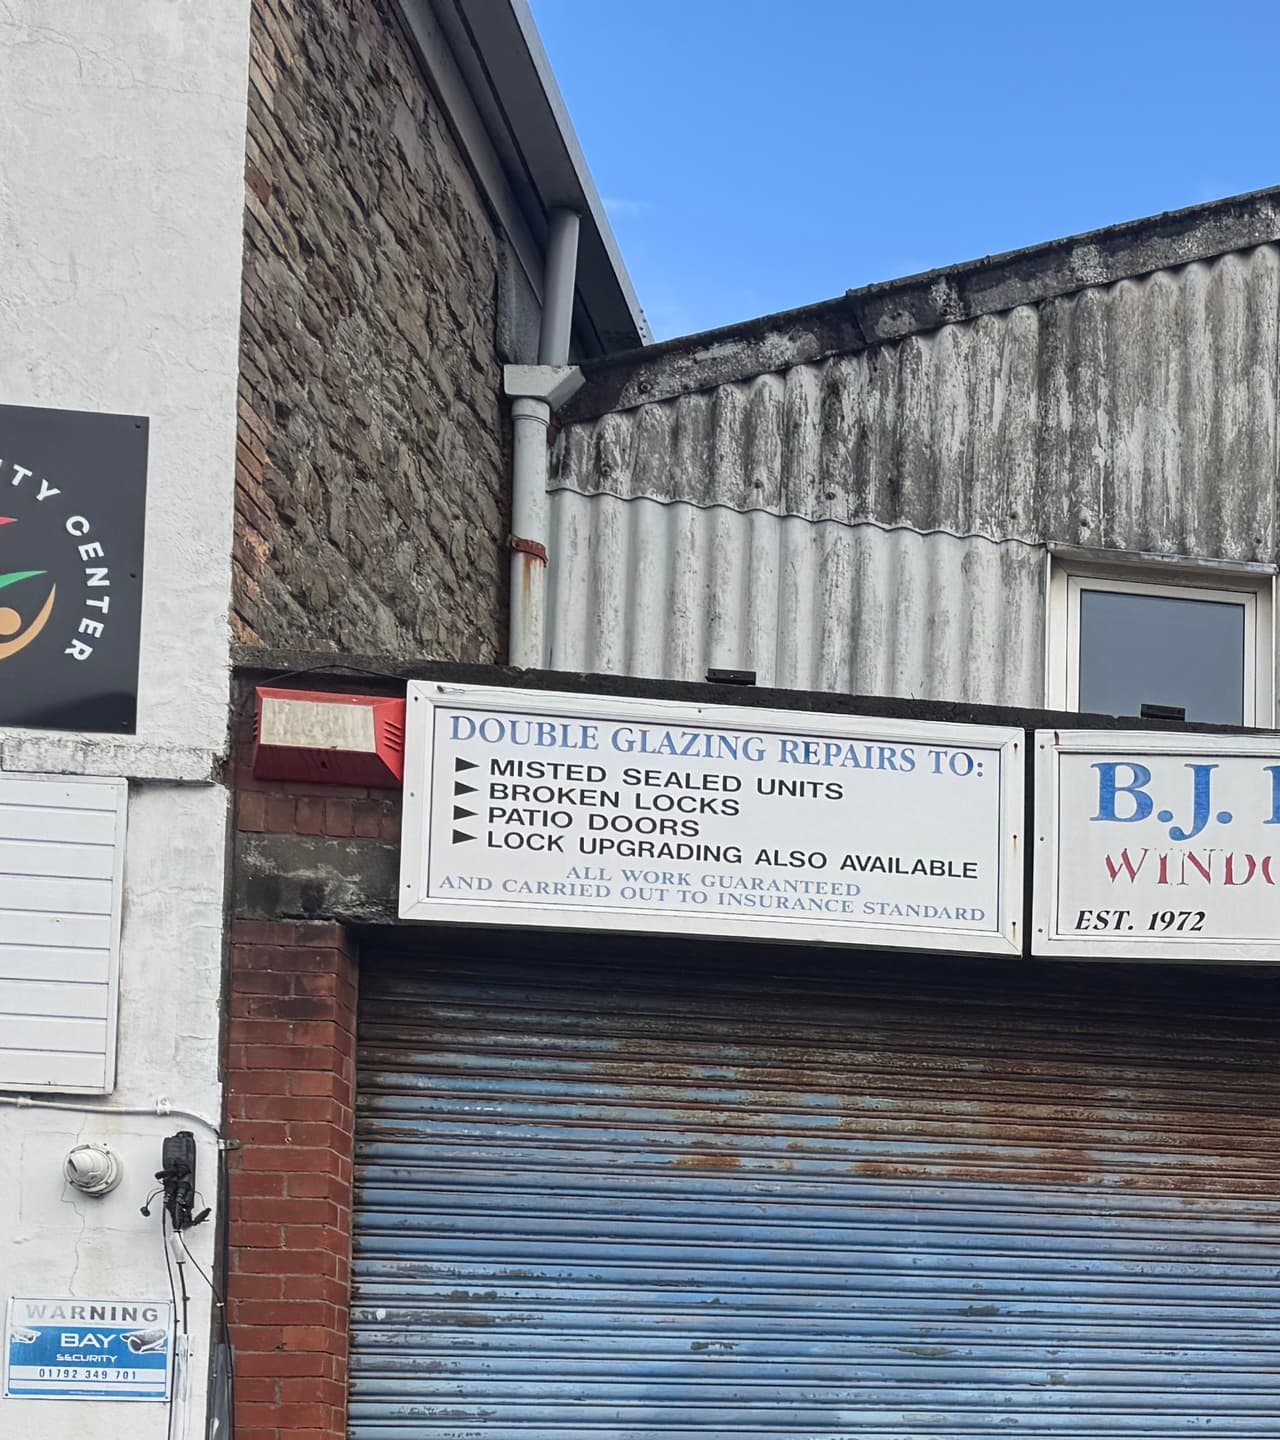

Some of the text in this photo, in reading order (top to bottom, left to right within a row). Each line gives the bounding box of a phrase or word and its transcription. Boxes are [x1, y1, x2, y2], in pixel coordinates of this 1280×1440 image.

[0, 459, 111, 661] TY CENTER
[449, 715, 984, 777] DOUBLE GLAZING REPAIRS TO:
[490, 758, 844, 801] MISTED SEALED UNITS
[489, 782, 740, 817] BROKEN LOCKS
[1088, 762, 1233, 841] B.J.
[488, 806, 700, 837] PATIO DOORS
[487, 830, 979, 880] LOCK UPGRADING ALSO AVAILABLE
[565, 865, 862, 897] ALL WORK GUARANTEED
[439, 875, 985, 922] AND CARRIED OUT TO INSURANCE STANDARD
[1073, 909, 1207, 932] EST. 1972
[25, 1303, 159, 1322] WARNING
[60, 1333, 118, 1348] BAY
[39, 1369, 137, 1380] 01792 349 701
[56, 1353, 118, 1363] SECURITY
